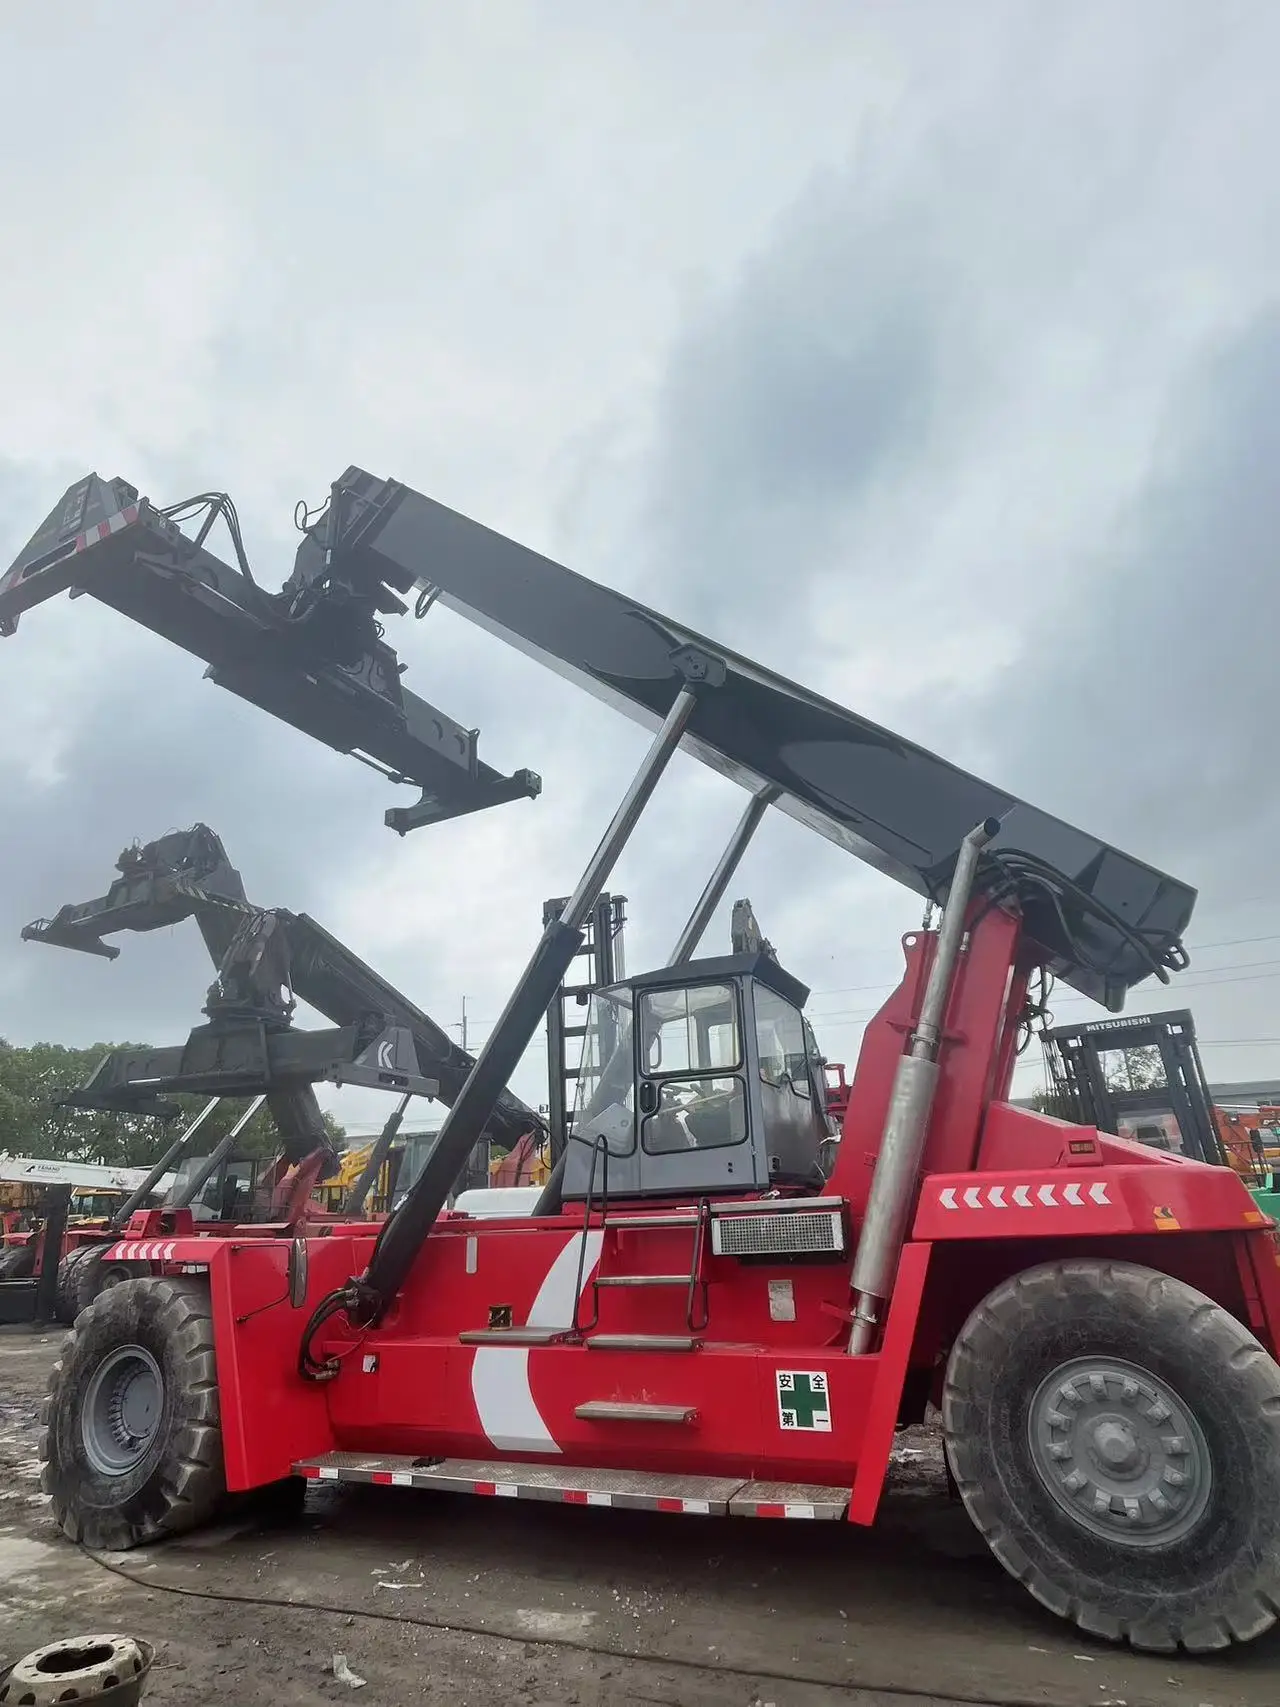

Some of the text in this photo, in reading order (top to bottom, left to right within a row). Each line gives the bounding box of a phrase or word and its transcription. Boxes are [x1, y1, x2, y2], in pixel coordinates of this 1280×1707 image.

[1086, 1016, 1151, 1032] MITSUBISHI
[779, 1374, 825, 1390] 安 全
[782, 1411, 795, 1427] 第
